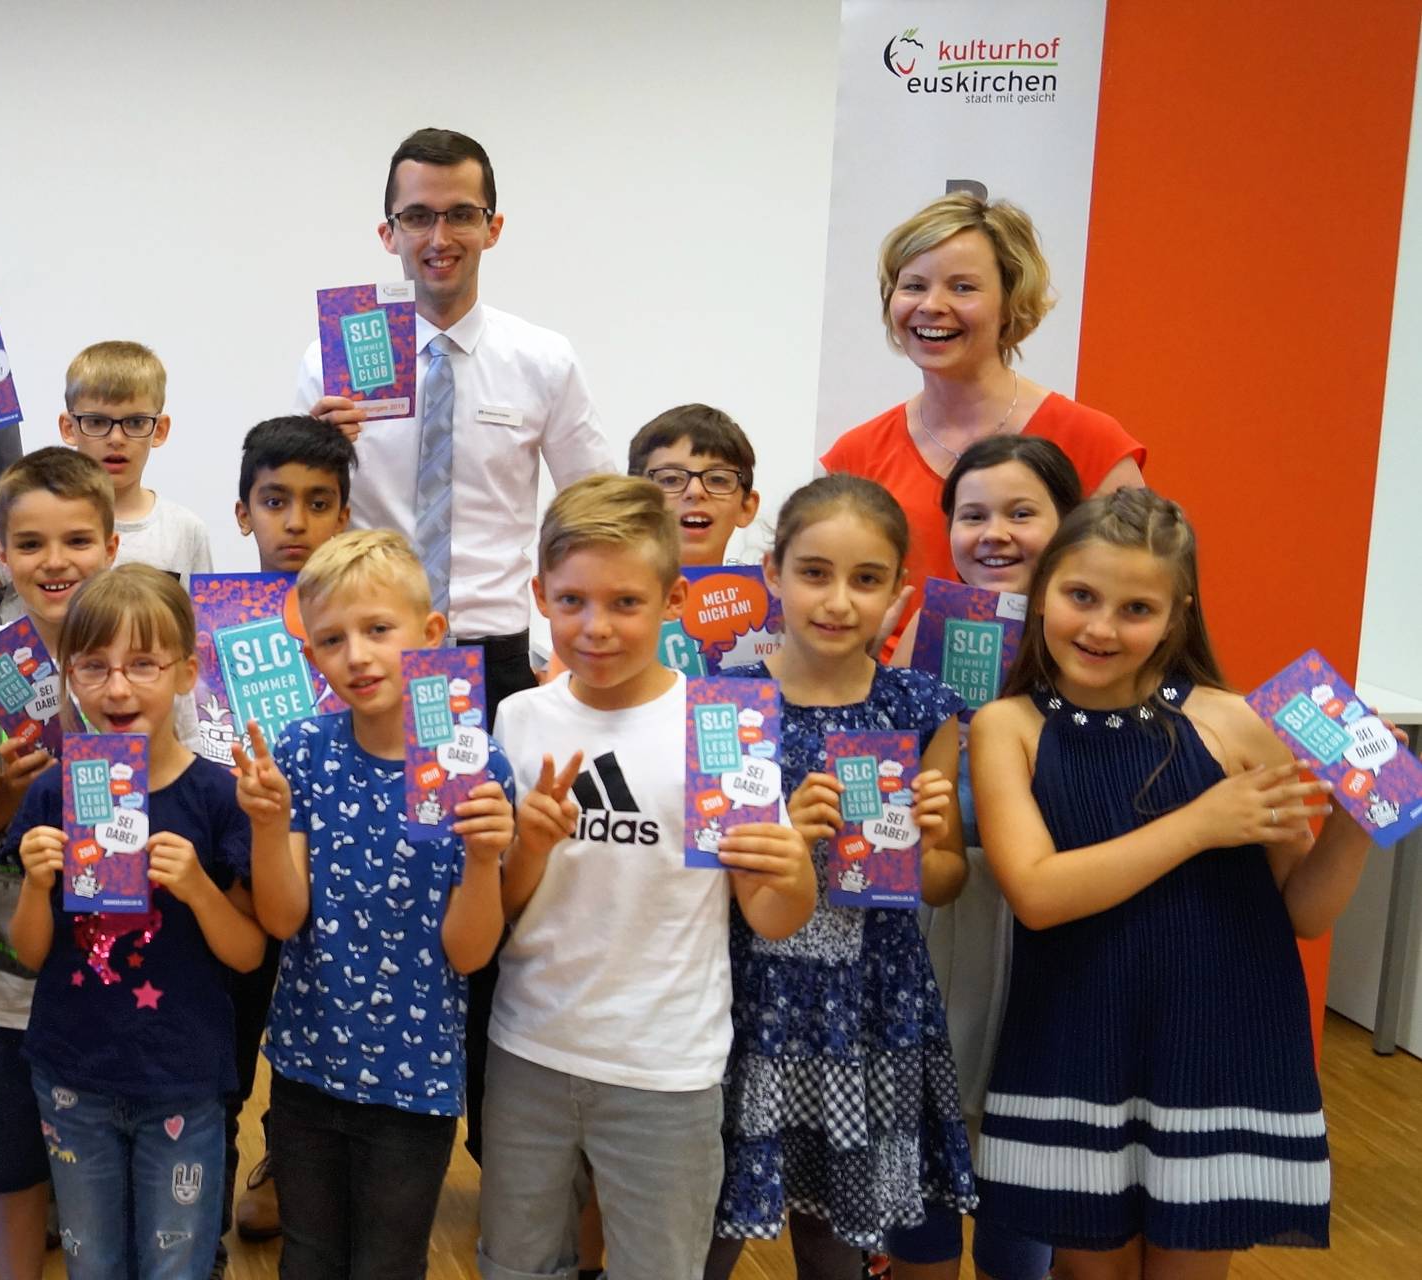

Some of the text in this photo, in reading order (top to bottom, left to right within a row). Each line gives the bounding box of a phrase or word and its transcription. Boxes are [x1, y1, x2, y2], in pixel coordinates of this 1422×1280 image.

[939, 38, 1060, 61] kulturhof
[907, 71, 1057, 93] euskirchen
[965, 93, 1055, 104] stadt mit gesicht
[349, 319, 382, 343] SLC
[357, 351, 386, 366] LESE
[359, 365, 388, 382] CLUB
[702, 587, 739, 608] MELD'
[697, 600, 751, 624] DICH AN!
[953, 629, 993, 656] SLC
[232, 632, 292, 677] SLC
[242, 673, 297, 697] SOMMER
[952, 668, 988, 685] LESE
[40, 685, 53, 696] SEI
[417, 684, 444, 704] SLC
[952, 687, 987, 701] LUB
[35, 696, 58, 711] DABE
[246, 690, 303, 722] LESE
[701, 711, 733, 731] SLC
[1284, 701, 1315, 731] SLC
[459, 734, 474, 747] SEI
[1355, 727, 1373, 741] SEI
[1355, 739, 1388, 758] DABEI!
[78, 766, 104, 785] SLC
[746, 765, 765, 780] SEI
[842, 764, 871, 782] SLC
[733, 777, 769, 798] DABEI!
[118, 816, 133, 829] SEI
[569, 809, 659, 845] idas
[886, 812, 905, 825] SEI
[106, 827, 138, 845] DABEI!
[874, 823, 910, 842] DABEI!
